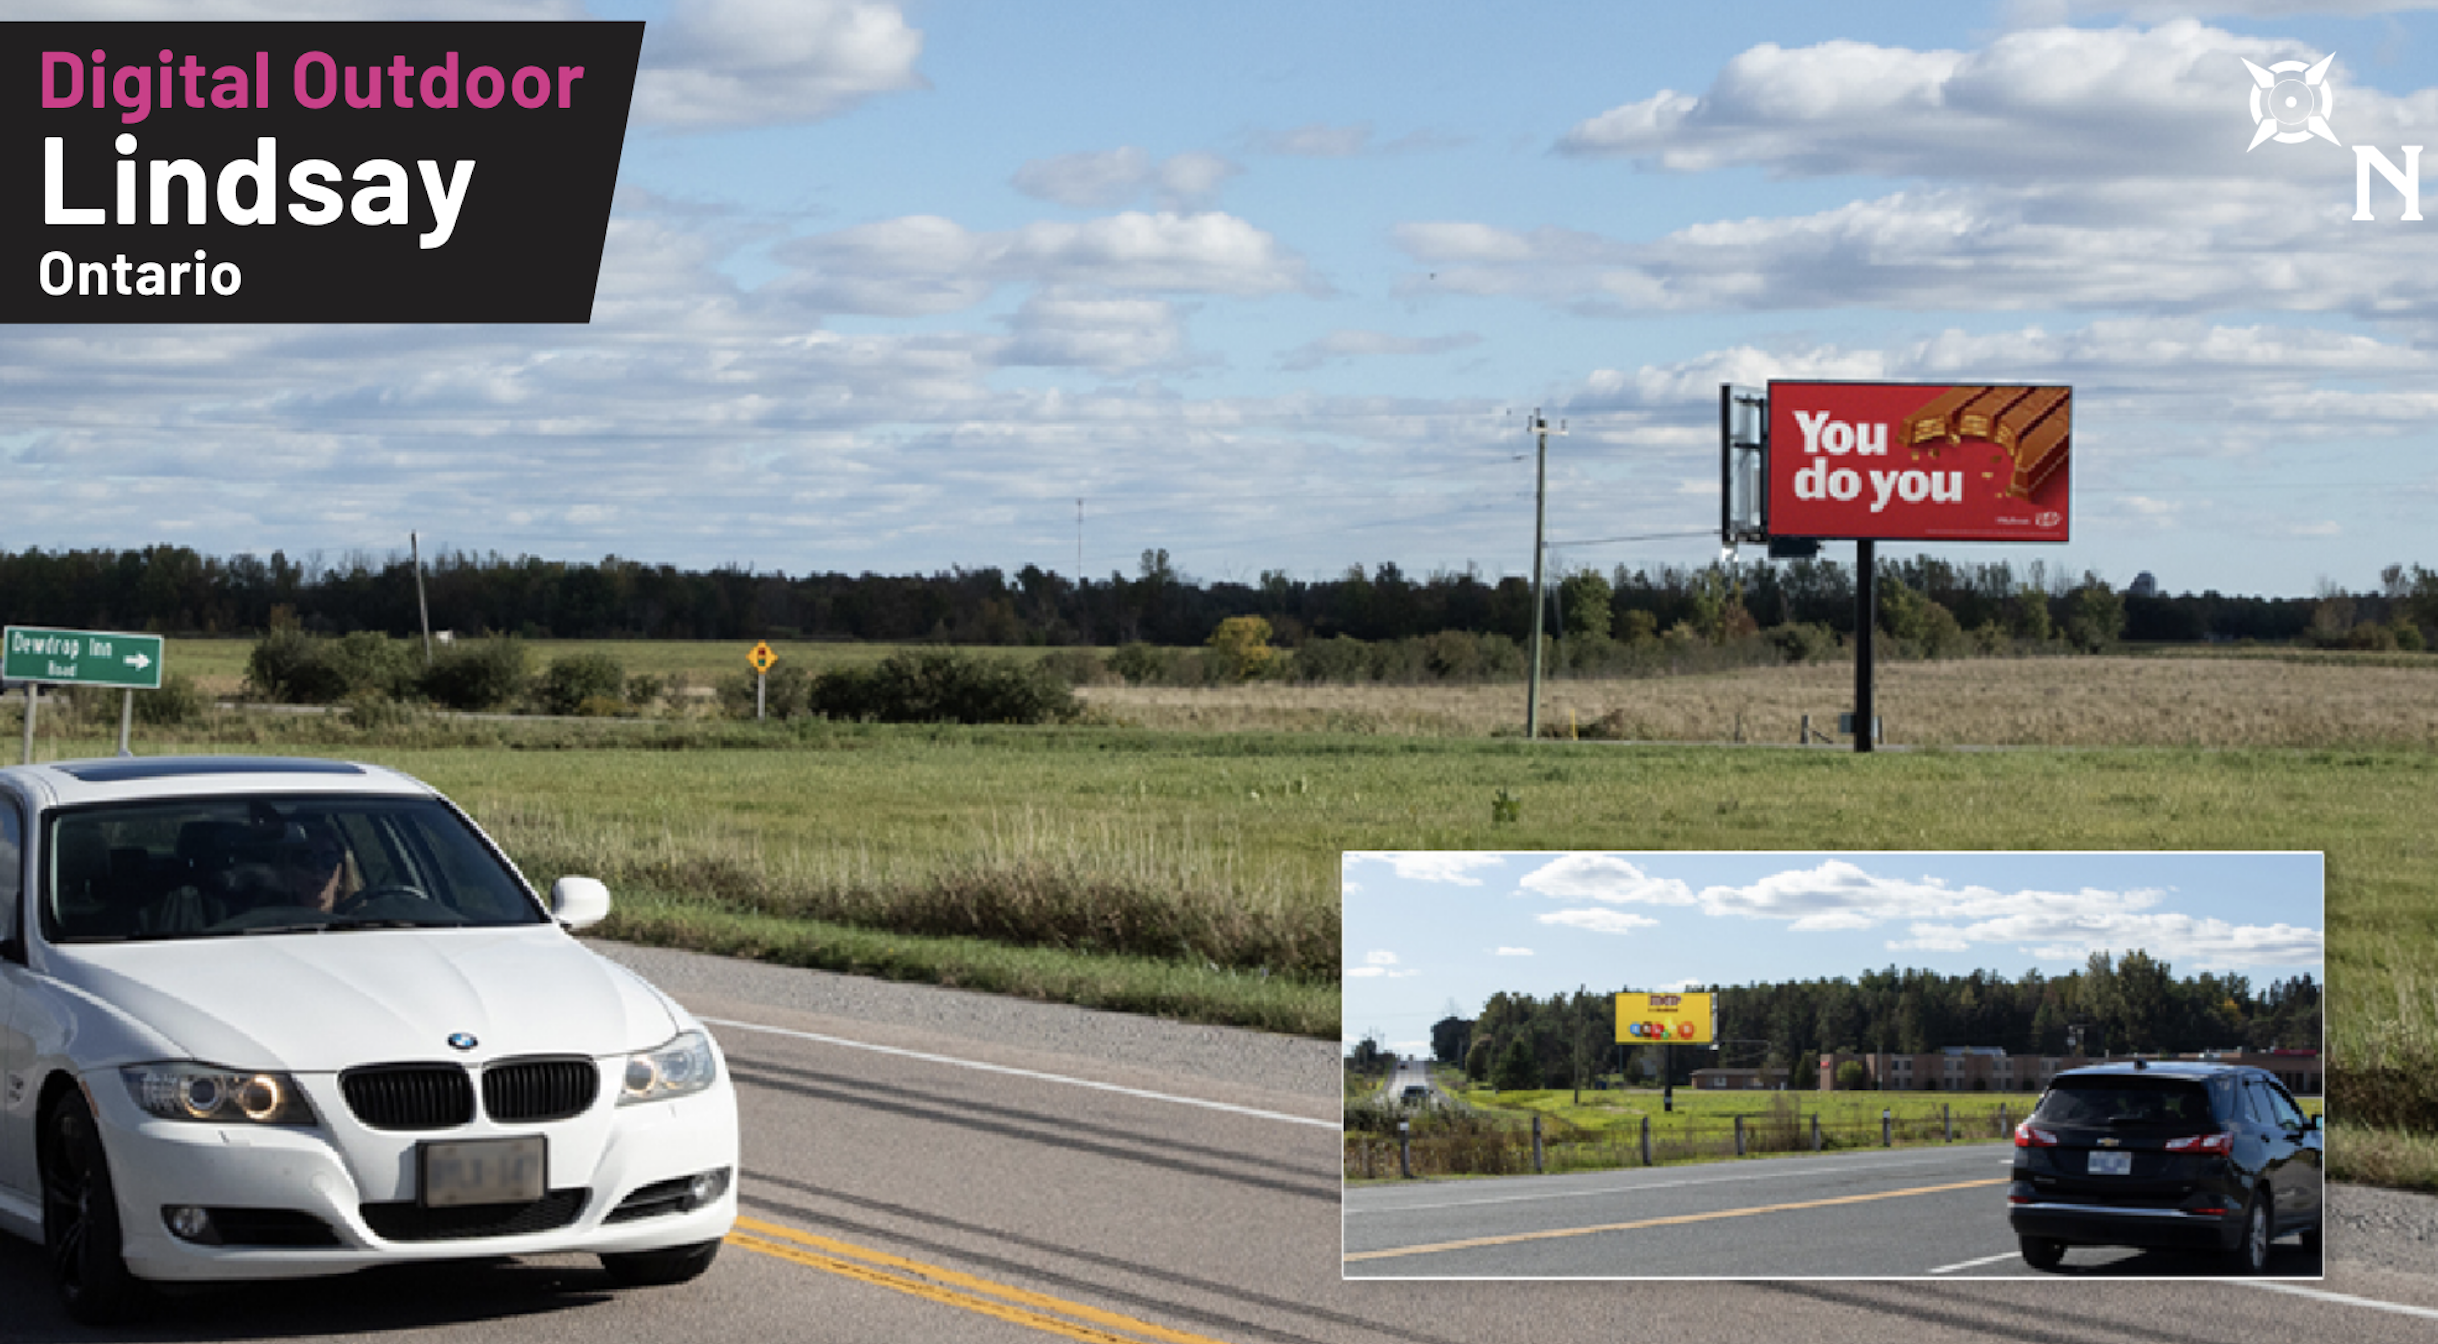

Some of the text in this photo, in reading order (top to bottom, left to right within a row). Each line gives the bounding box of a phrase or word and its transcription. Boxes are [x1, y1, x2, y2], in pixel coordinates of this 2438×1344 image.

[1793, 410, 1888, 456] You
[1793, 457, 1965, 513] do you
[11, 631, 113, 660] Dewdrop Inn
